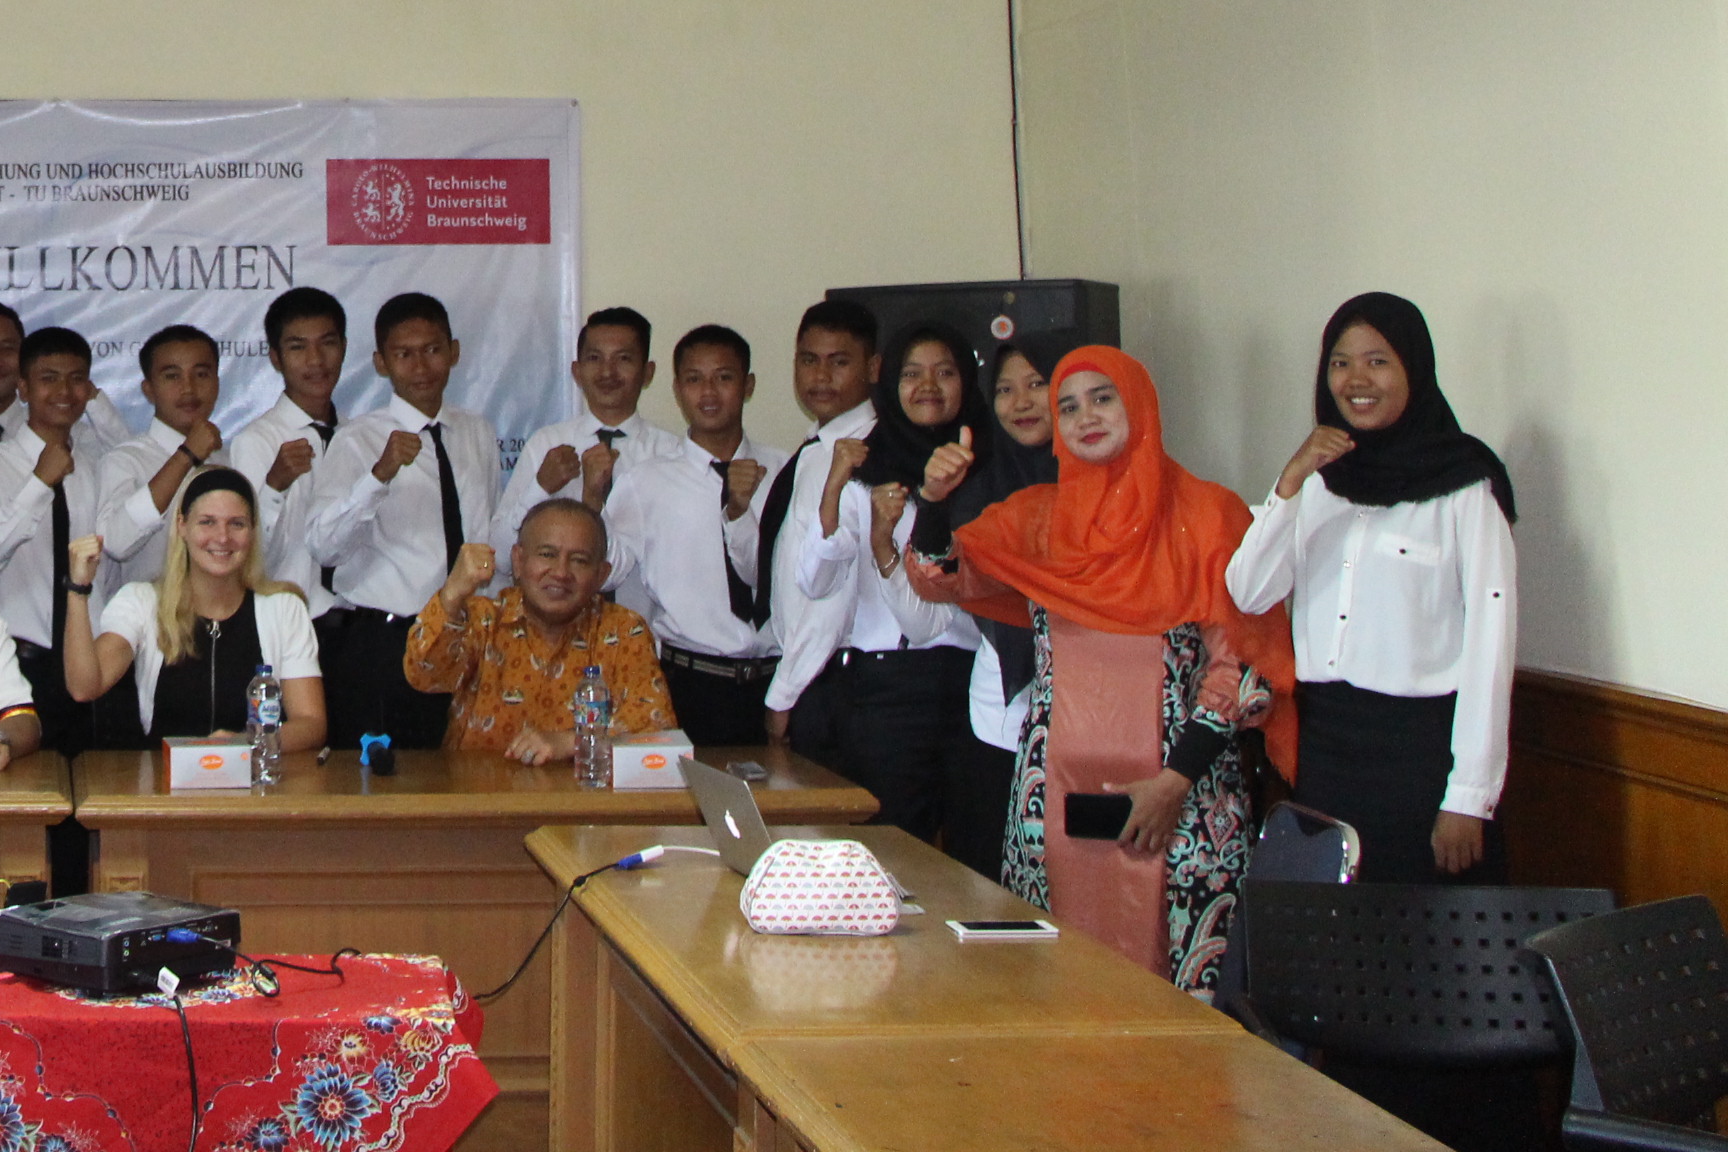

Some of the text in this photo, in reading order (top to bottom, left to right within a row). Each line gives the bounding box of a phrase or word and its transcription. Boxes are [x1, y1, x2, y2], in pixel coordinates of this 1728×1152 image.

[47, 163, 83, 180] UND
[88, 162, 304, 180] HOCHSCHULAUSBILDUNG
[426, 176, 507, 190] Technische
[24, 185, 47, 201] TU
[52, 185, 190, 201] BRAUNSCHWEIG
[427, 195, 508, 209] Universität
[427, 213, 527, 230] Braunschweig
